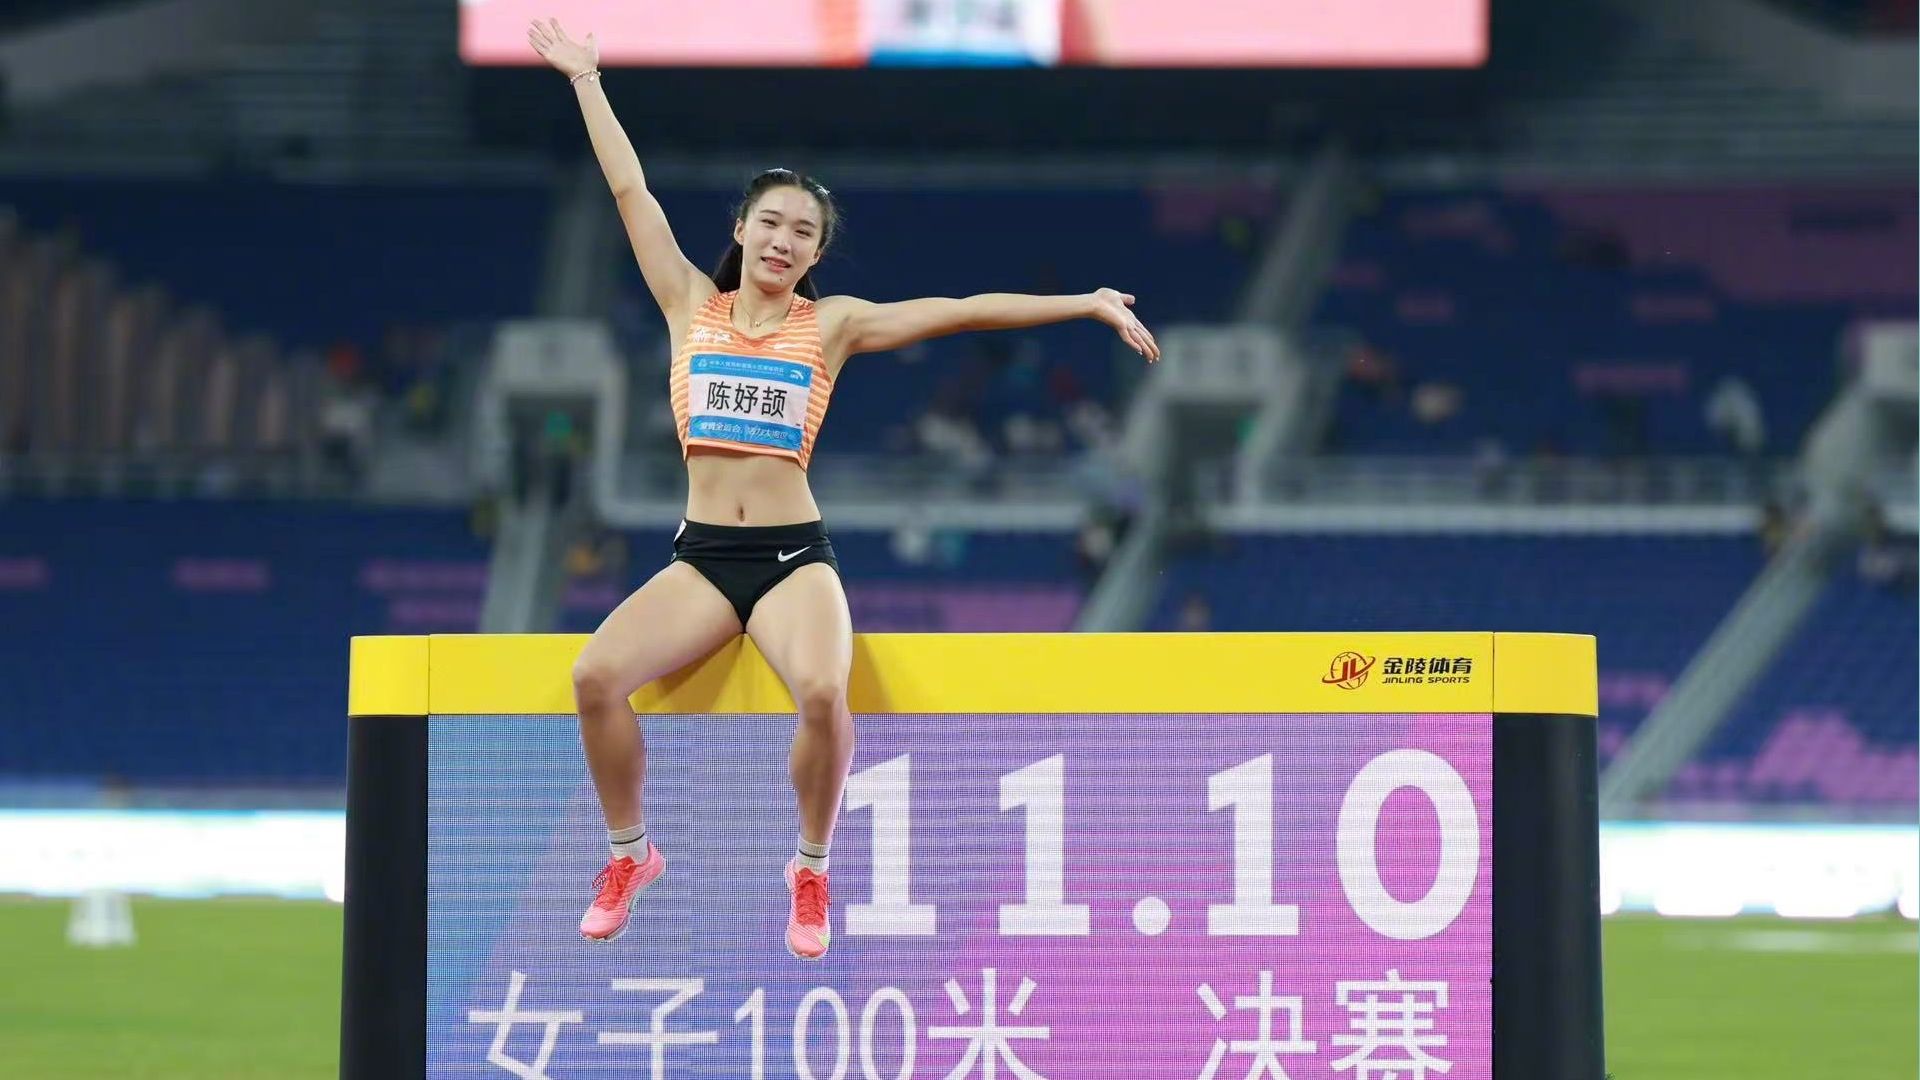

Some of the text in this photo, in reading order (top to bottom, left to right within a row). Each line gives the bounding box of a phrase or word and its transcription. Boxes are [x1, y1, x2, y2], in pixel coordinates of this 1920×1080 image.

[706, 380, 788, 419] 陈妤颉
[1382, 657, 1473, 674] 金陵体育
[846, 751, 1479, 939] 11.10
[468, 968, 1454, 1080] 女子100米 决赛
